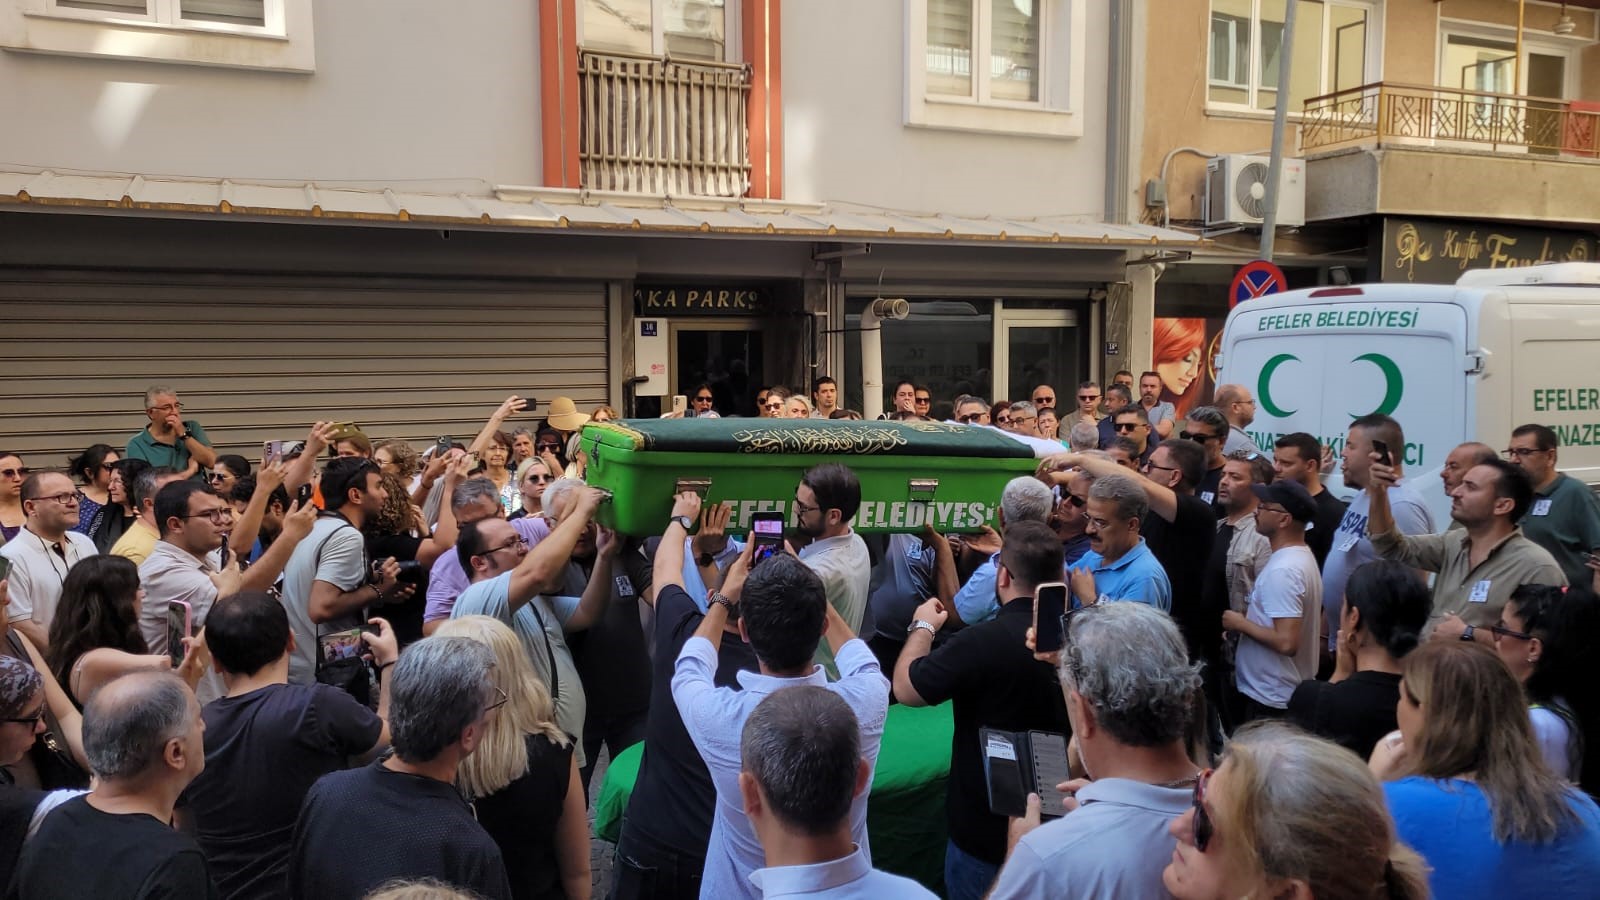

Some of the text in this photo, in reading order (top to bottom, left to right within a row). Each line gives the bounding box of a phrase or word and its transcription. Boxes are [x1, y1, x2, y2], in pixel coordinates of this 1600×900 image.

[1258, 306, 1420, 331] EFELER BELEDİYESİ
[1533, 388, 1600, 411] EFELER
